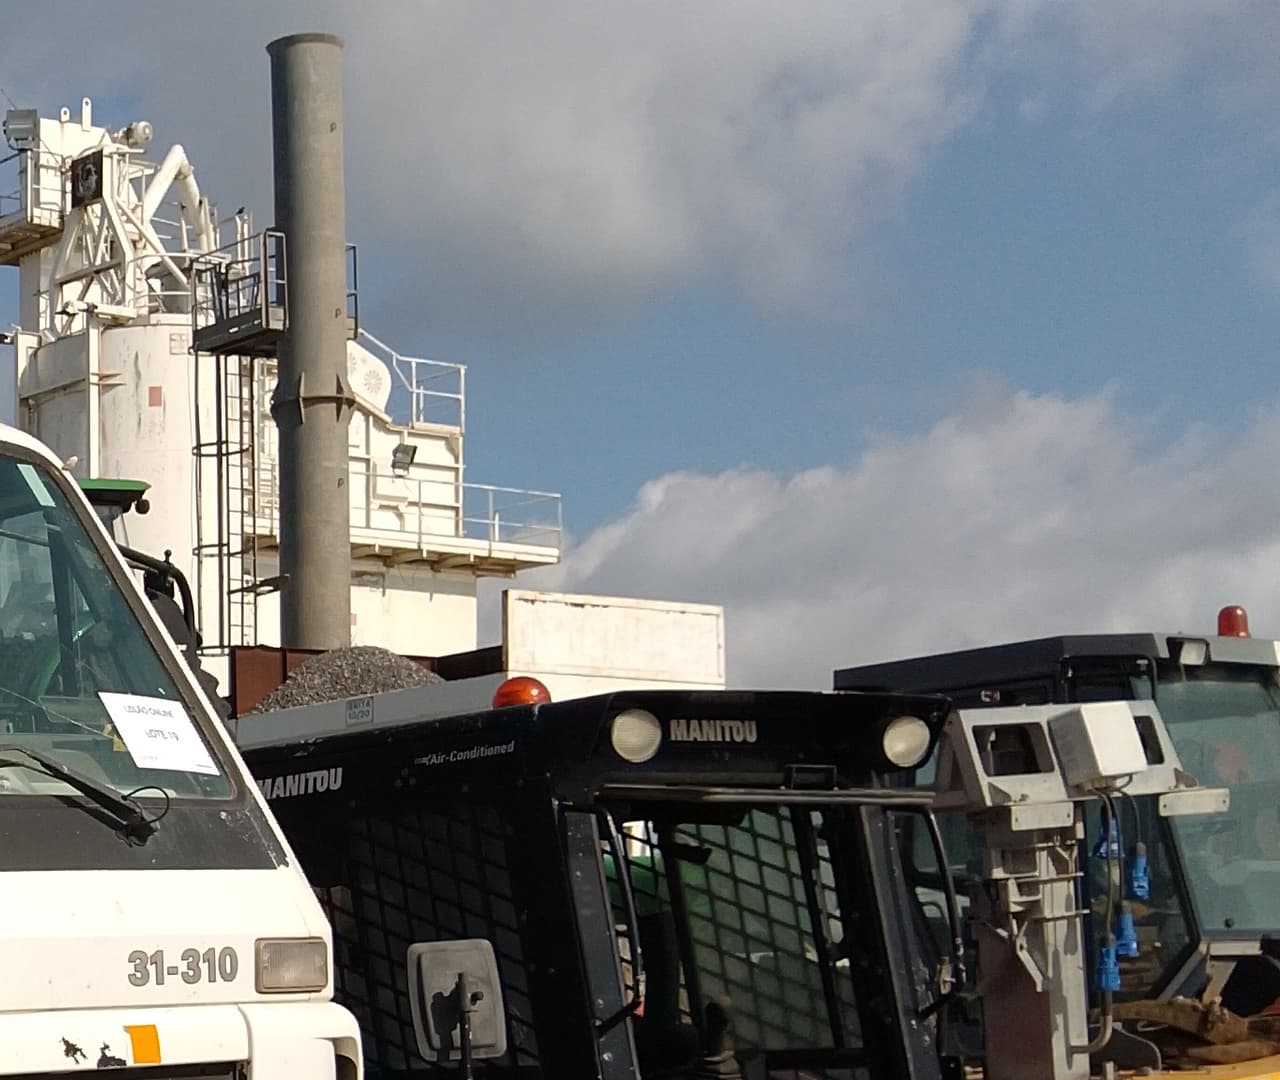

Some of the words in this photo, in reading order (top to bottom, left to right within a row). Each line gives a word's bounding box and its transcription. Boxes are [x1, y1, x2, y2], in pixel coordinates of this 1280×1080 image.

[670, 719, 757, 742] MANITOU
[429, 740, 515, 765] Air-Conditioned
[256, 767, 343, 800] MANITOU
[127, 946, 239, 987] 31-310
